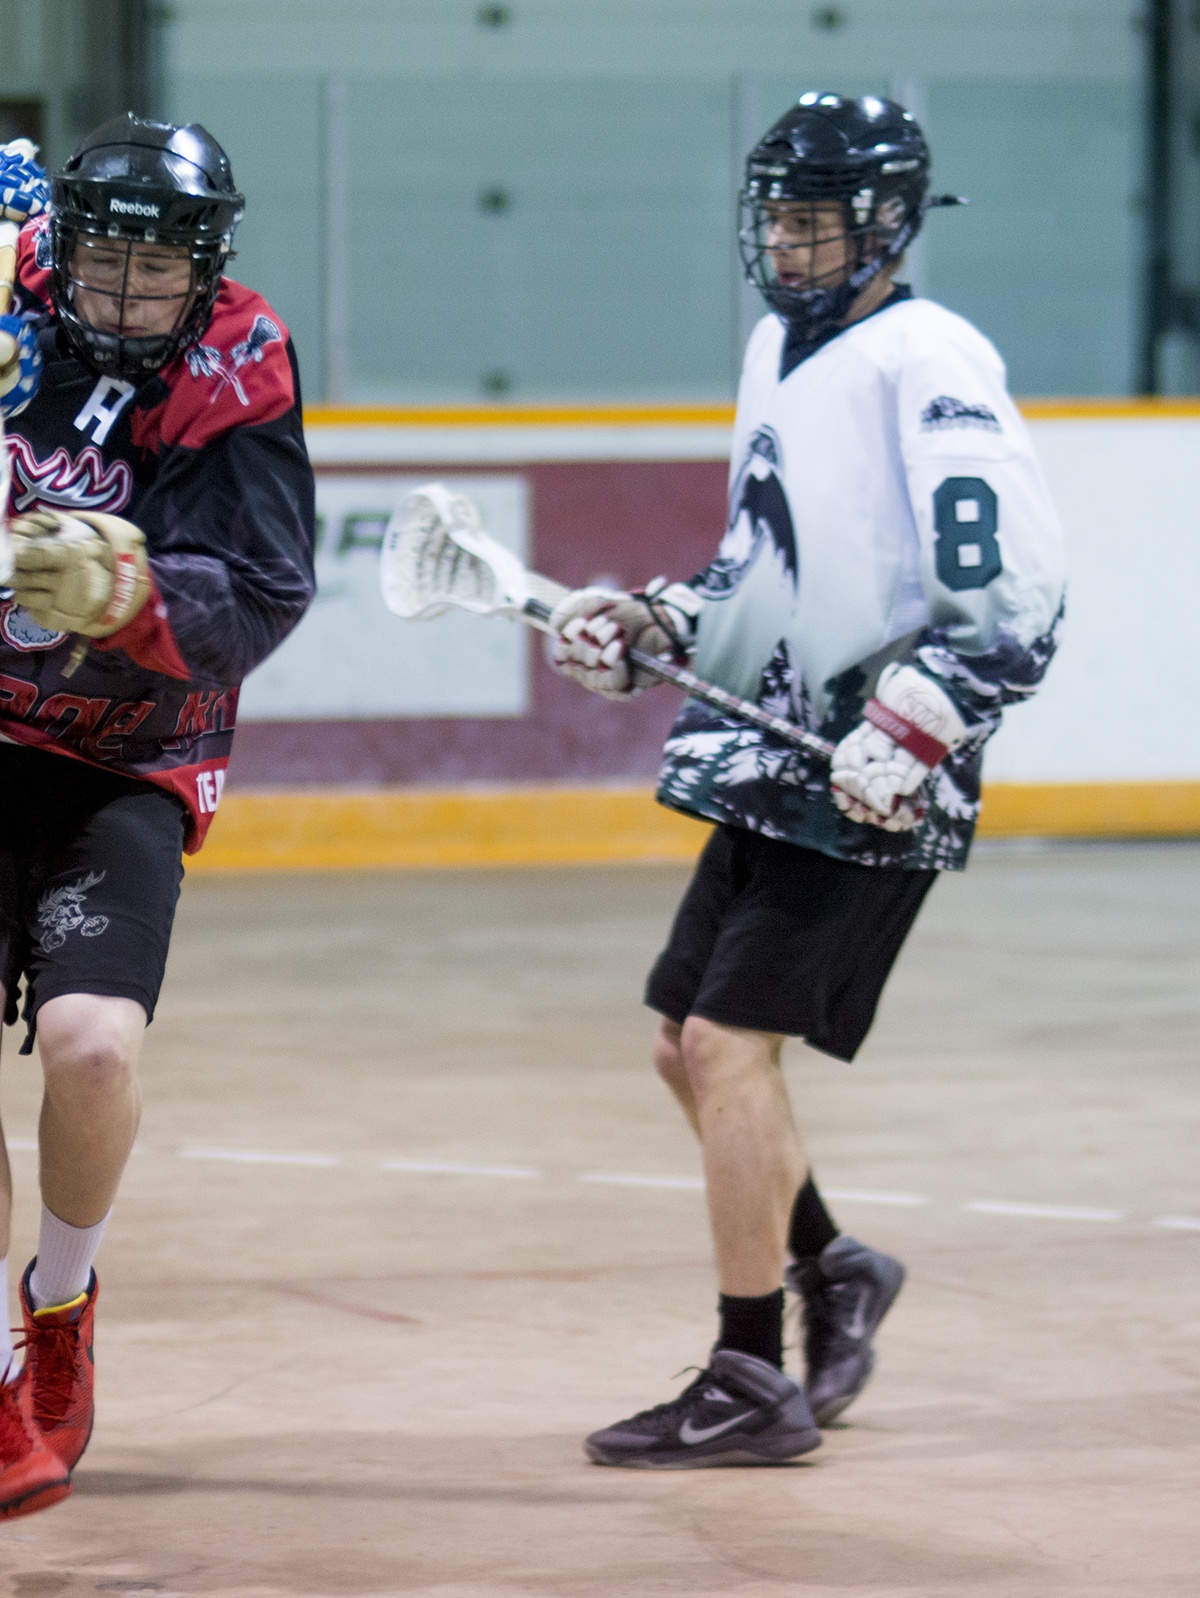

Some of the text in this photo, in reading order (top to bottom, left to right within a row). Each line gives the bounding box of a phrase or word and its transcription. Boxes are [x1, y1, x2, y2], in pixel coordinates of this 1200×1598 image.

[109, 198, 159, 218] Reebok
[73, 375, 136, 446] A
[933, 476, 1003, 592] 8
